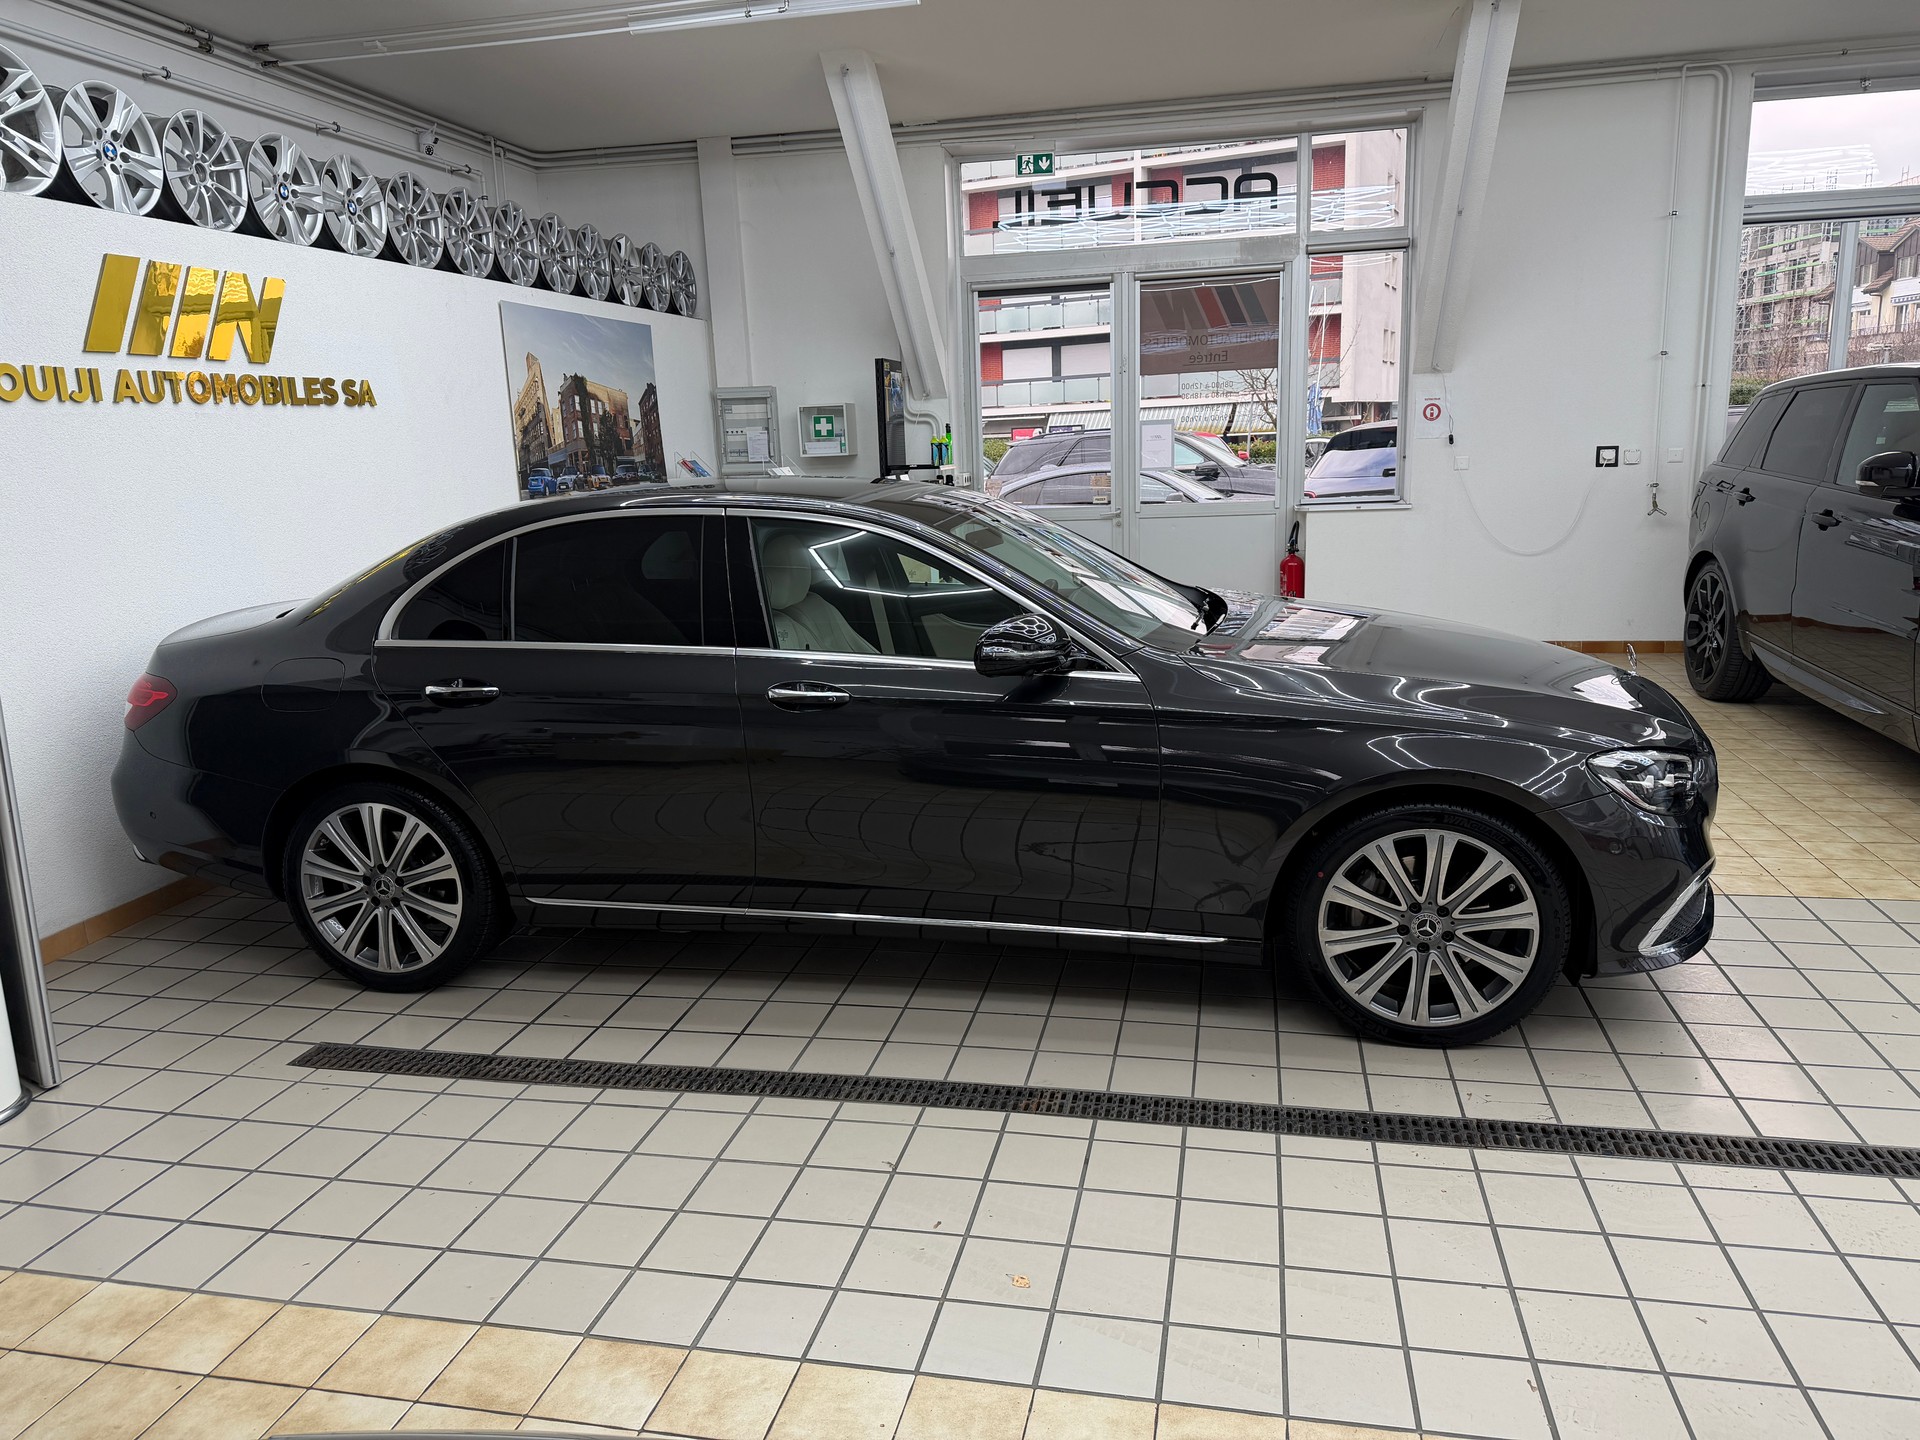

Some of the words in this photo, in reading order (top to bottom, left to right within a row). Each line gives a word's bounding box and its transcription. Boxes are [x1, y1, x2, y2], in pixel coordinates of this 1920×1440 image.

[113, 368, 339, 406] AUTOMOBILES
[343, 378, 377, 407] SA
[1335, 997, 1389, 1035] NEXEN
